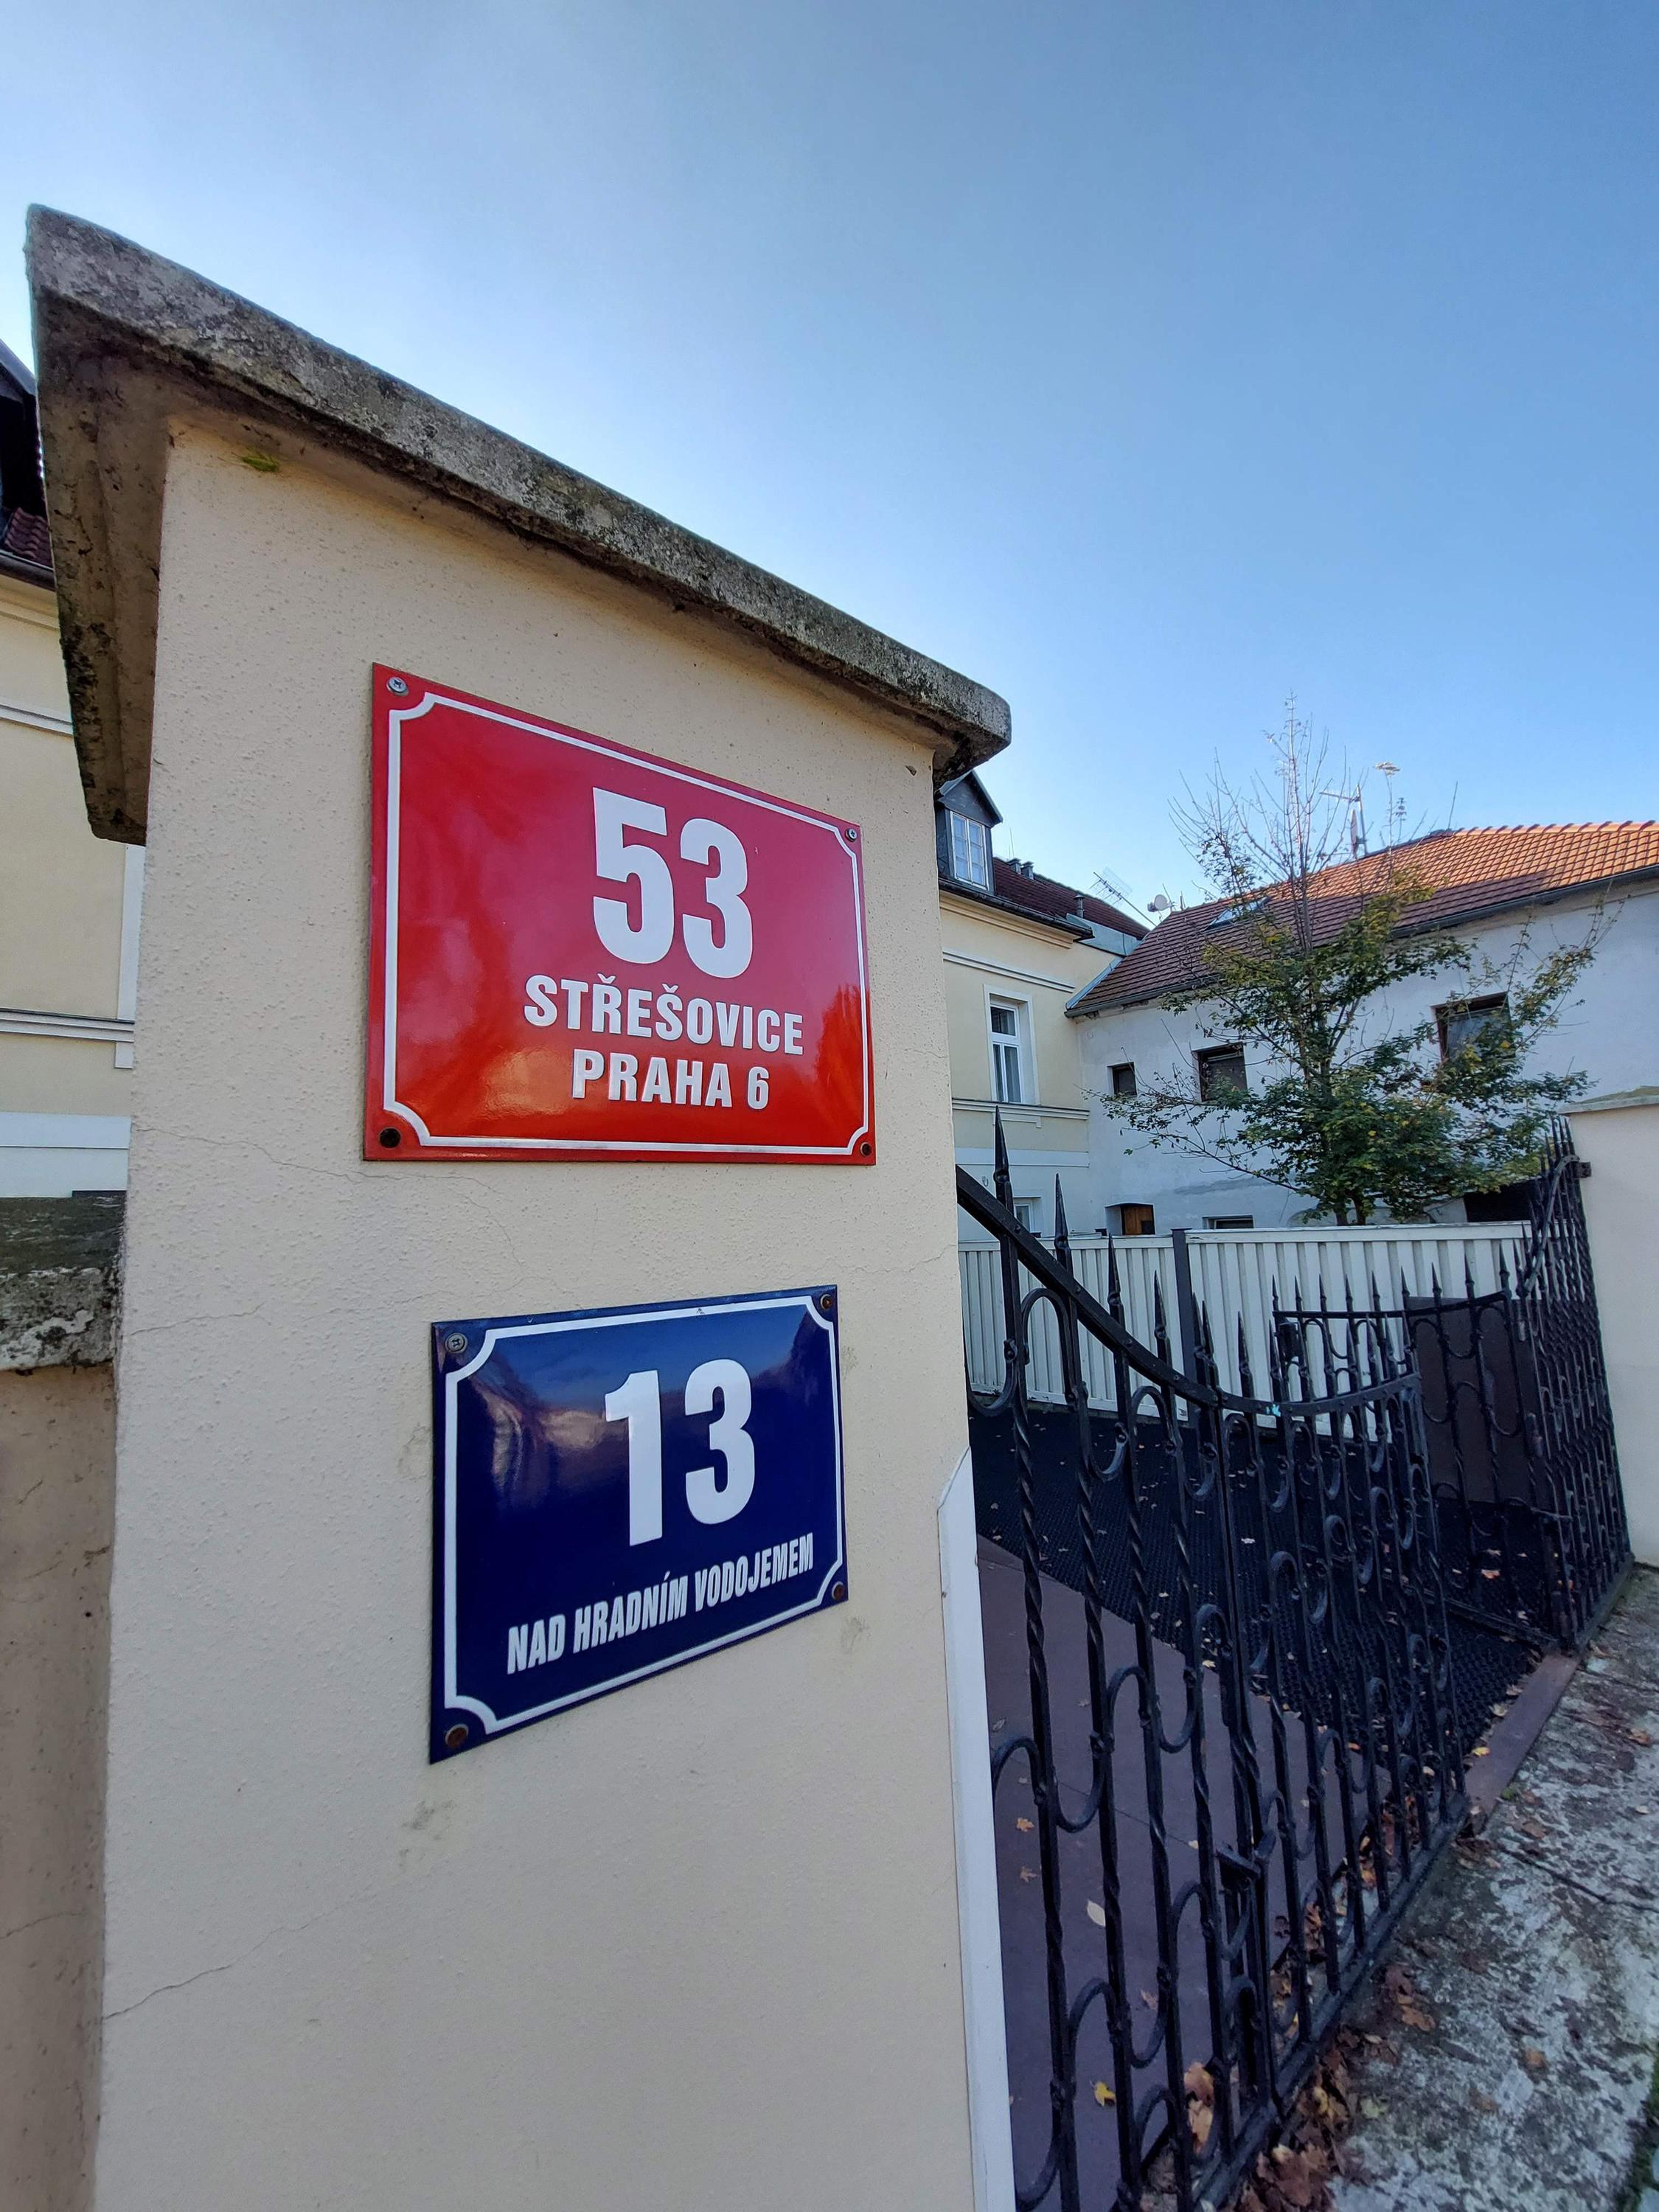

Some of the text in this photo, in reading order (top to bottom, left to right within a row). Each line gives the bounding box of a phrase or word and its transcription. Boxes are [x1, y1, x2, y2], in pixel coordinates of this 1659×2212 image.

[593, 787, 754, 979] 53
[524, 973, 804, 1055] STŘEŠOVICE
[572, 1048, 769, 1110] PRAHA 6
[605, 1358, 756, 1547] 13
[507, 1532, 814, 1675] NAD HRADNÍM VODOJEMEM
